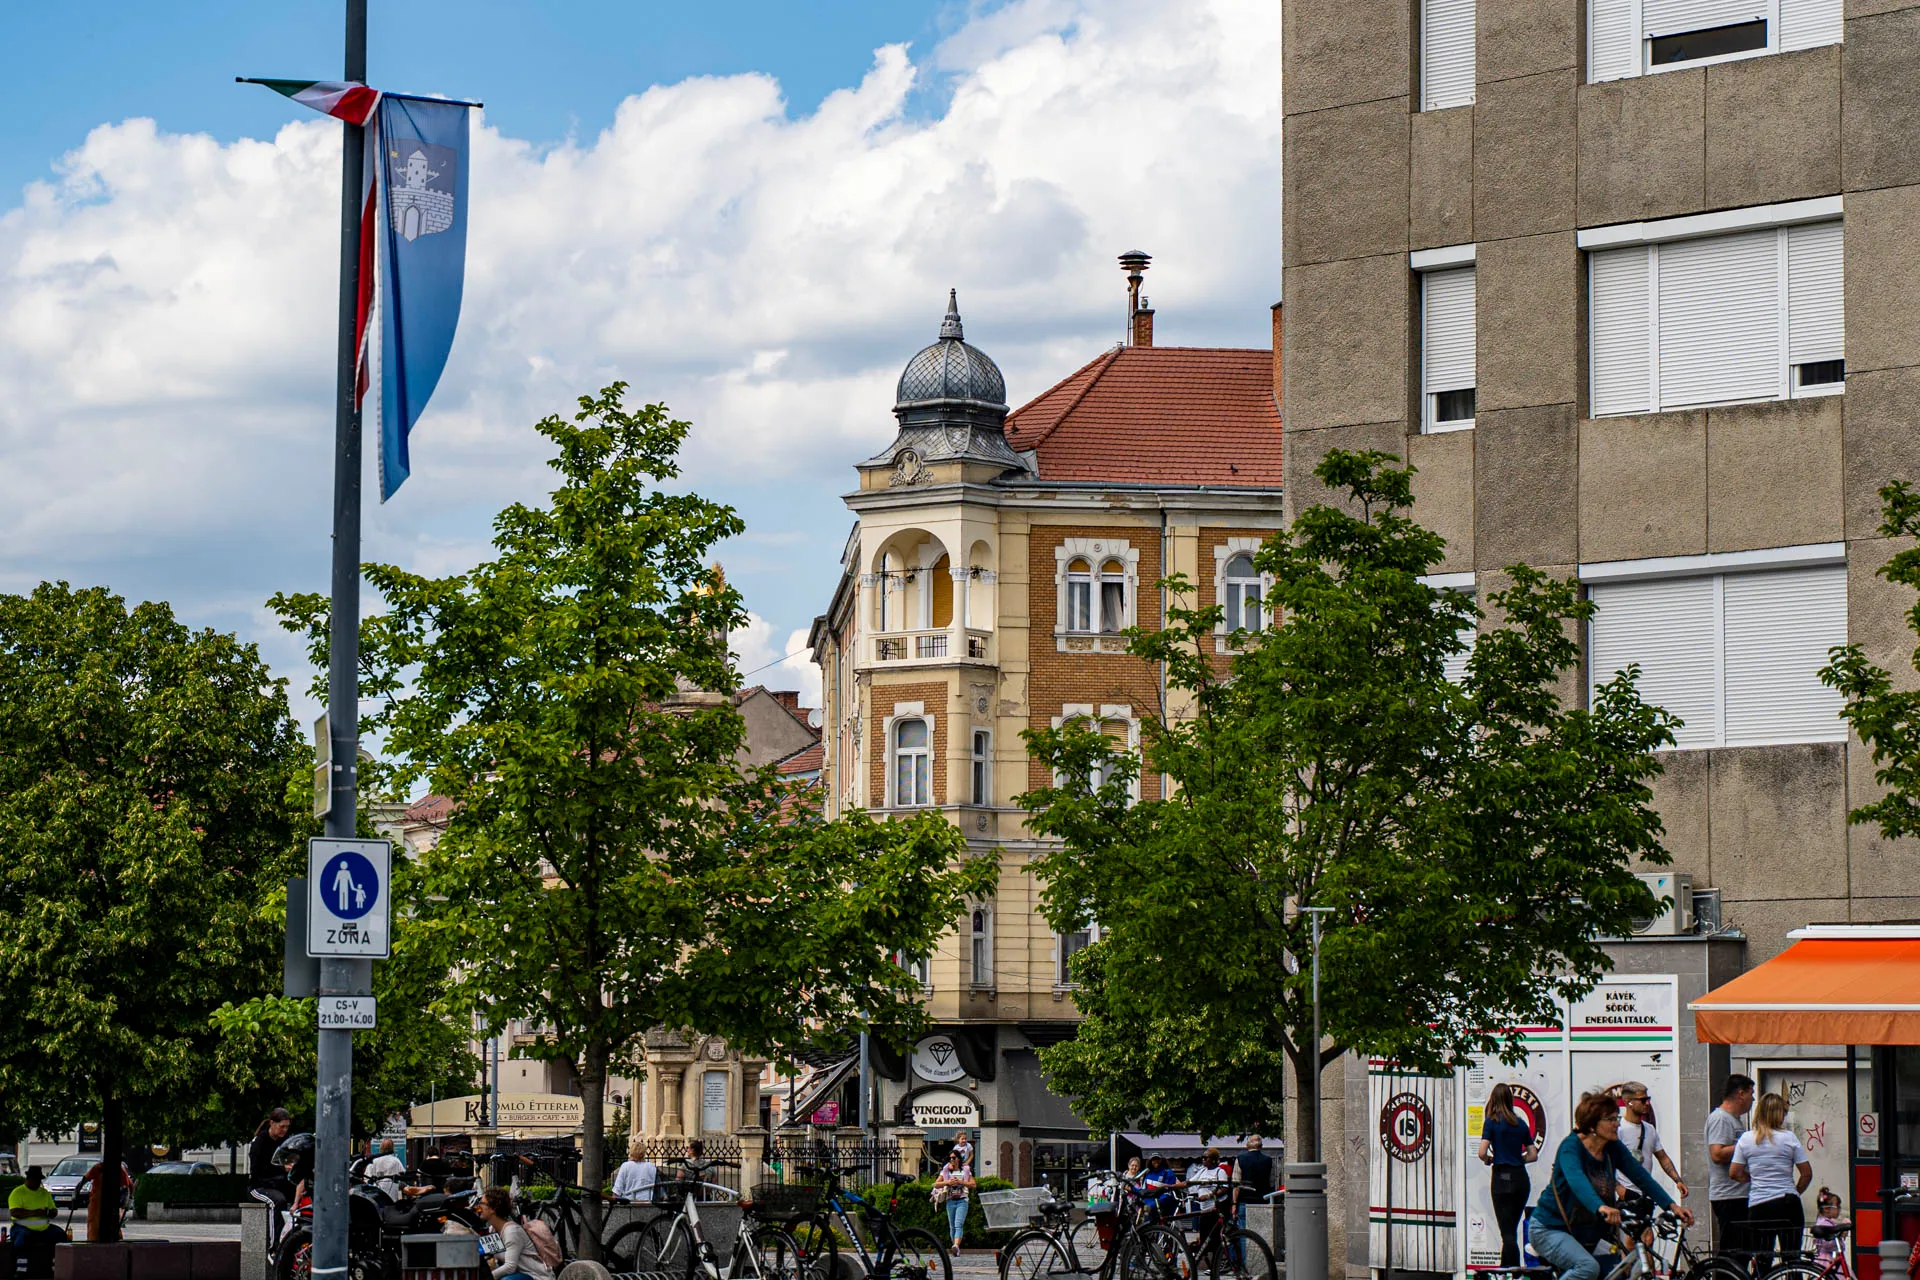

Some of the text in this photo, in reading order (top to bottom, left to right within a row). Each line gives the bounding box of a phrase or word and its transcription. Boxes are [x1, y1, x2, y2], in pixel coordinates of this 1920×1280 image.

[1606, 991, 1636, 1001] KÁVÉK,
[336, 1000, 358, 1010] CS-V
[1605, 1002, 1637, 1013] SÖRÖK,
[321, 1014, 373, 1025] 21.00-14.00
[1585, 1015, 1658, 1024] ENERGIA ITALOK,
[529, 1099, 579, 1111] ÉTTEREM
[913, 1105, 972, 1115] VINCIGOLD
[921, 1117, 967, 1125] & DIAMOND
[1399, 1118, 1416, 1137] 18
